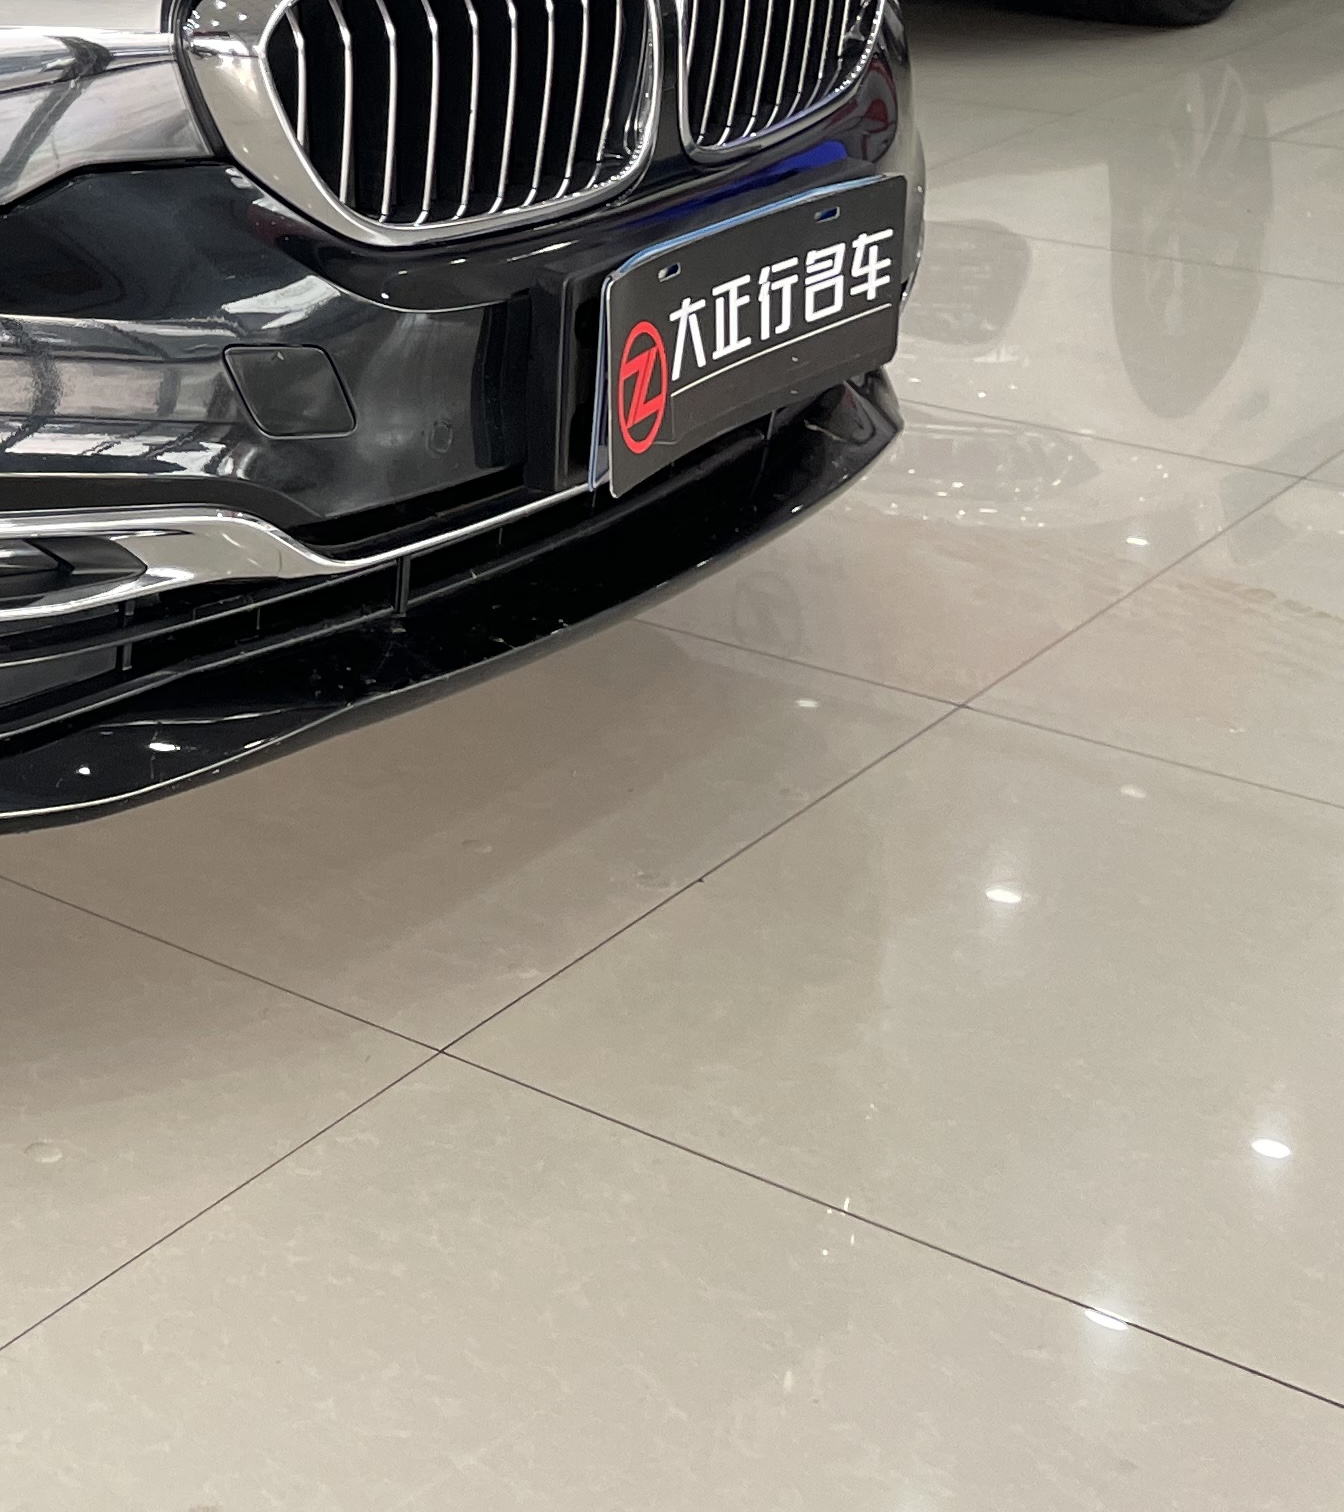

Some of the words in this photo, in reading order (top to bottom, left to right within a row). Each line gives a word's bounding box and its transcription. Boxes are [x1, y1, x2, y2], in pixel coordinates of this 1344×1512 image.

[669, 228, 894, 381] 大正行名车
